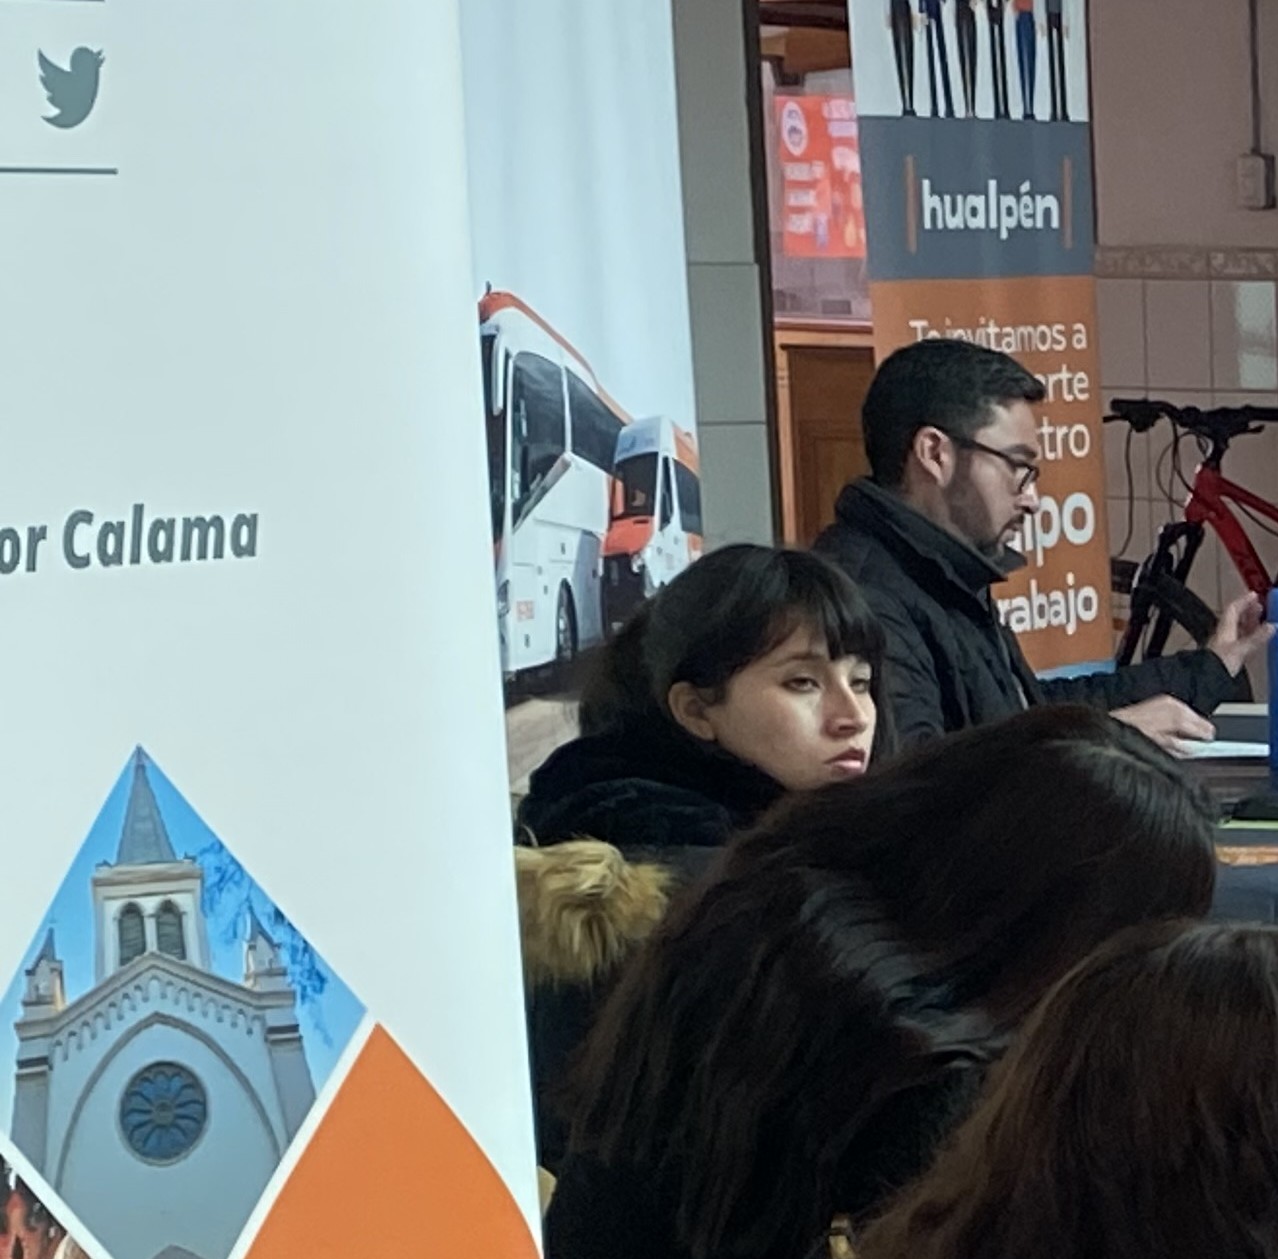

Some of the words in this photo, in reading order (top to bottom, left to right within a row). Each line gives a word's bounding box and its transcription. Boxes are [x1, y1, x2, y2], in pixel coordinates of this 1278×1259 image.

[922, 178, 1060, 240] hualpén
[1071, 322, 1088, 350] a
[1036, 416, 1091, 461] tro
[62, 502, 259, 570] Calama
[1007, 491, 1095, 568] ipo
[997, 571, 1098, 635] rabajo
